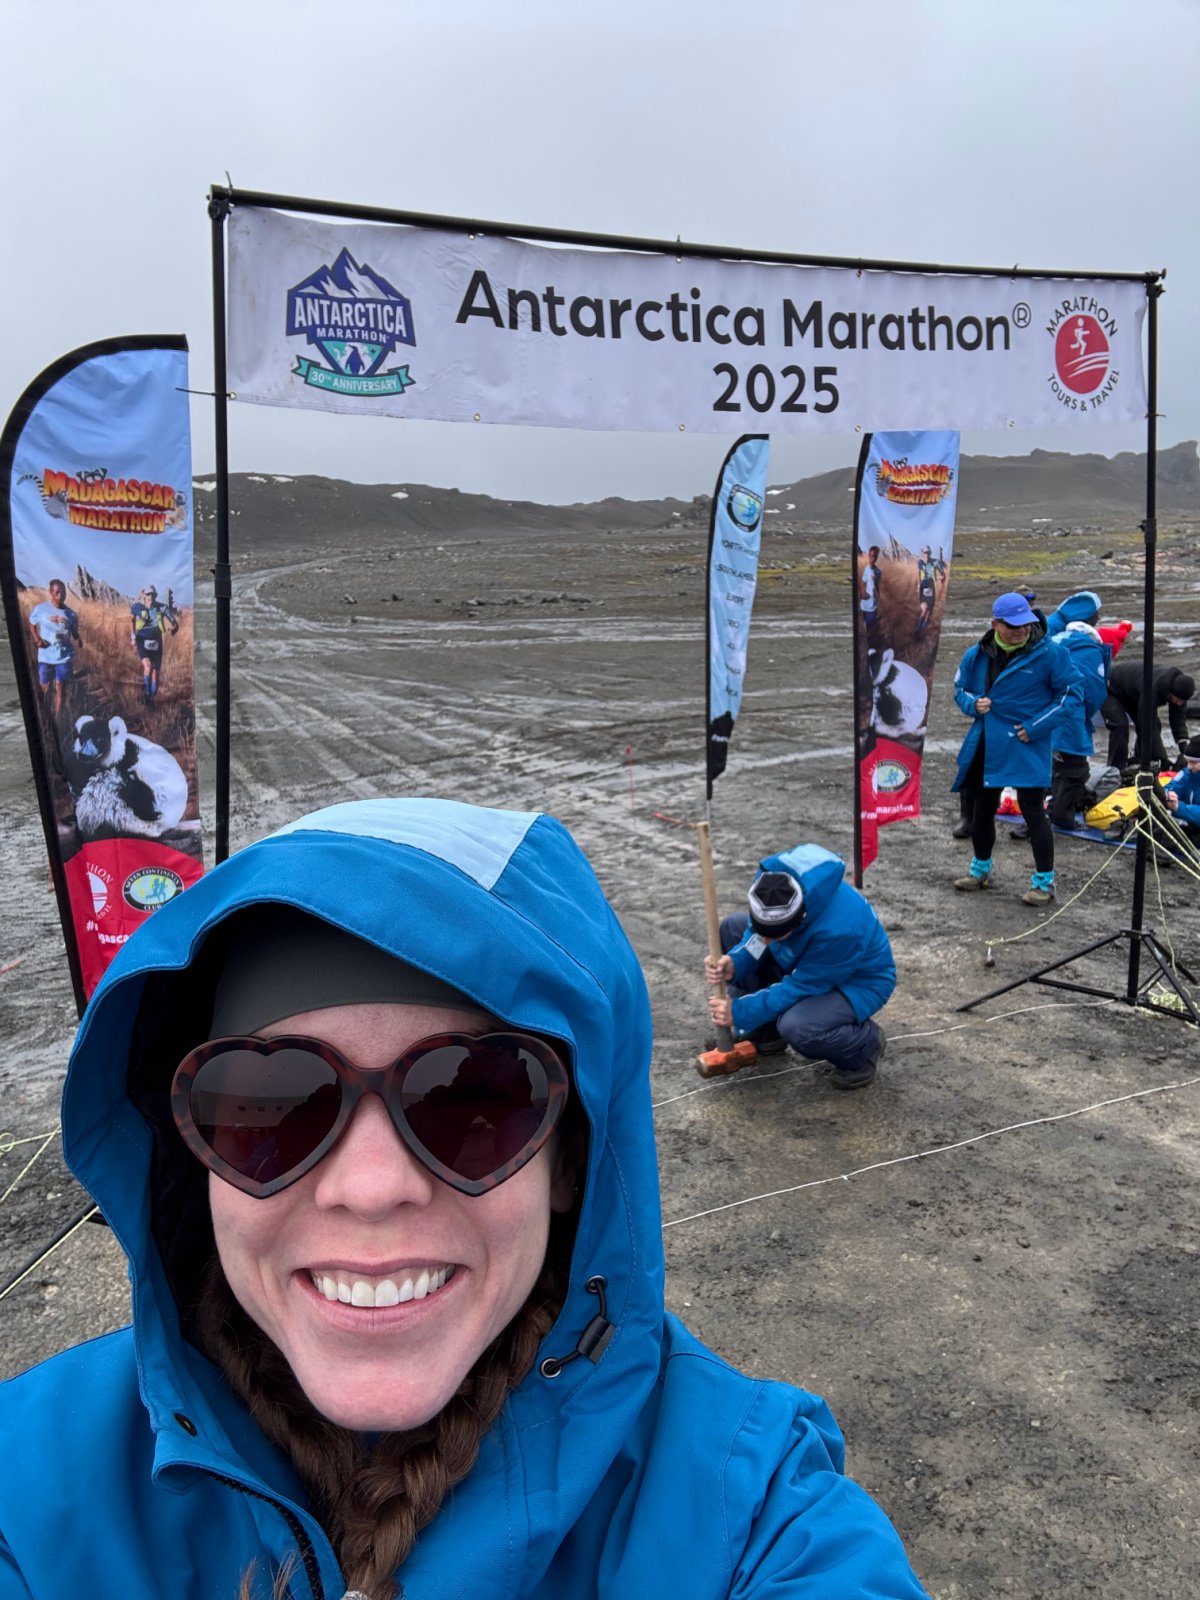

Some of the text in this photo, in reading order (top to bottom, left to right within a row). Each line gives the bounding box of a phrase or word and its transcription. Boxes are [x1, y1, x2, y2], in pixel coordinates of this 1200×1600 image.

[294, 297, 407, 338] ANTARCTICA
[456, 269, 765, 347] Antarctica
[1046, 296, 1118, 338] MARATHON
[316, 327, 388, 343] MARATHON
[332, 377, 398, 391] ANNIVERSARY
[713, 362, 840, 414] 2025
[1048, 369, 1120, 411] TOURS & TRAVEL
[43, 468, 176, 510] MADAGASCAR
[69, 505, 166, 534] MARATHON
